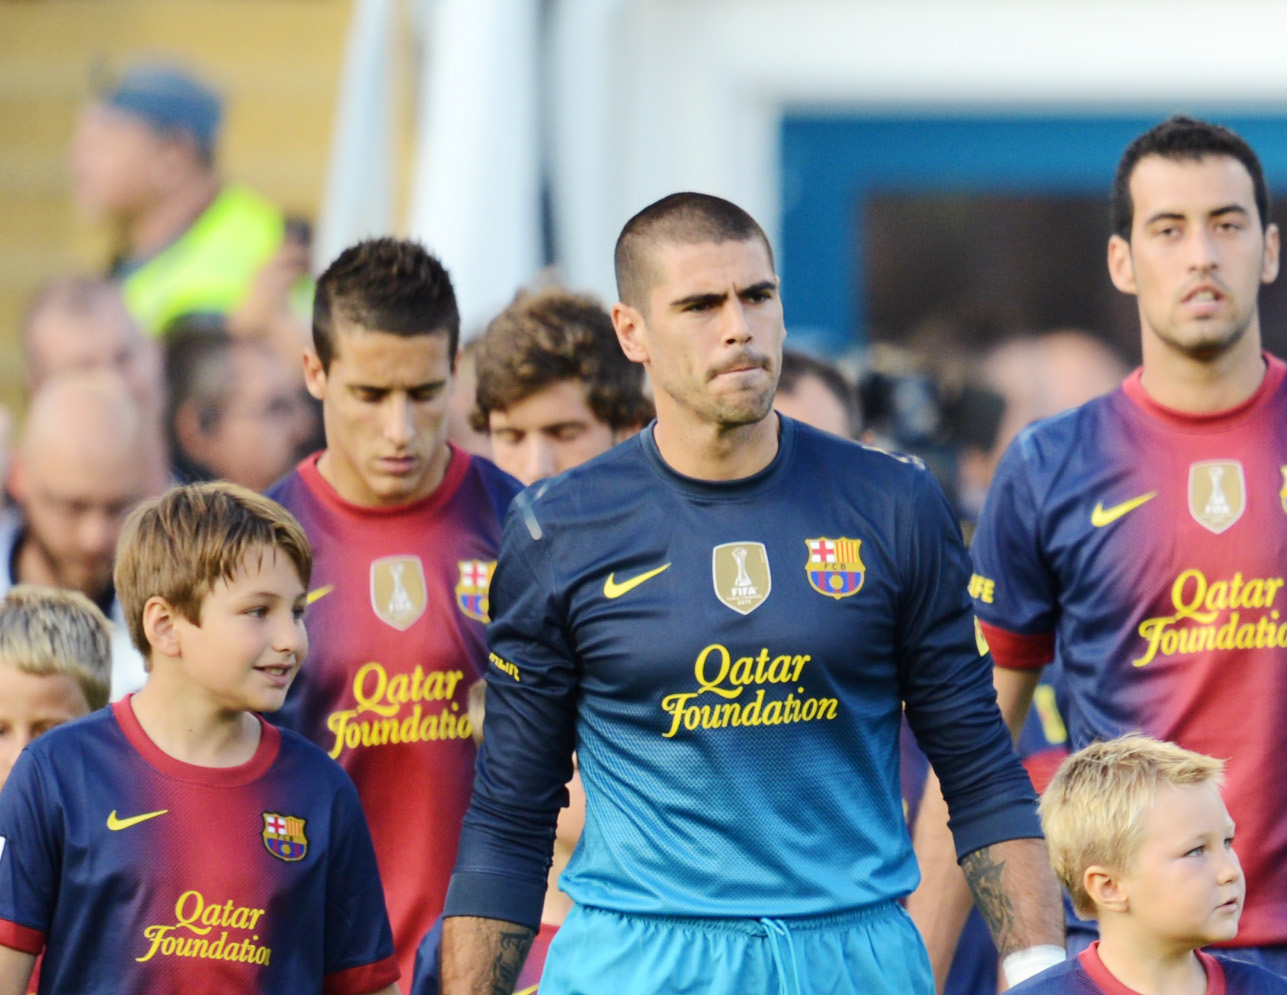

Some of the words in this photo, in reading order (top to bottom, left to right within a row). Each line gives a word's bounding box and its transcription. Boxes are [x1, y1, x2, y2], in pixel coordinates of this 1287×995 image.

[732, 586, 756, 597] FIFA
[1171, 568, 1284, 624] Qatar
[353, 661, 464, 717] Qatar
[694, 643, 811, 698] Qatar
[327, 702, 473, 759] Foundatio
[661, 686, 838, 738] Foundation
[175, 890, 265, 935] Qatar
